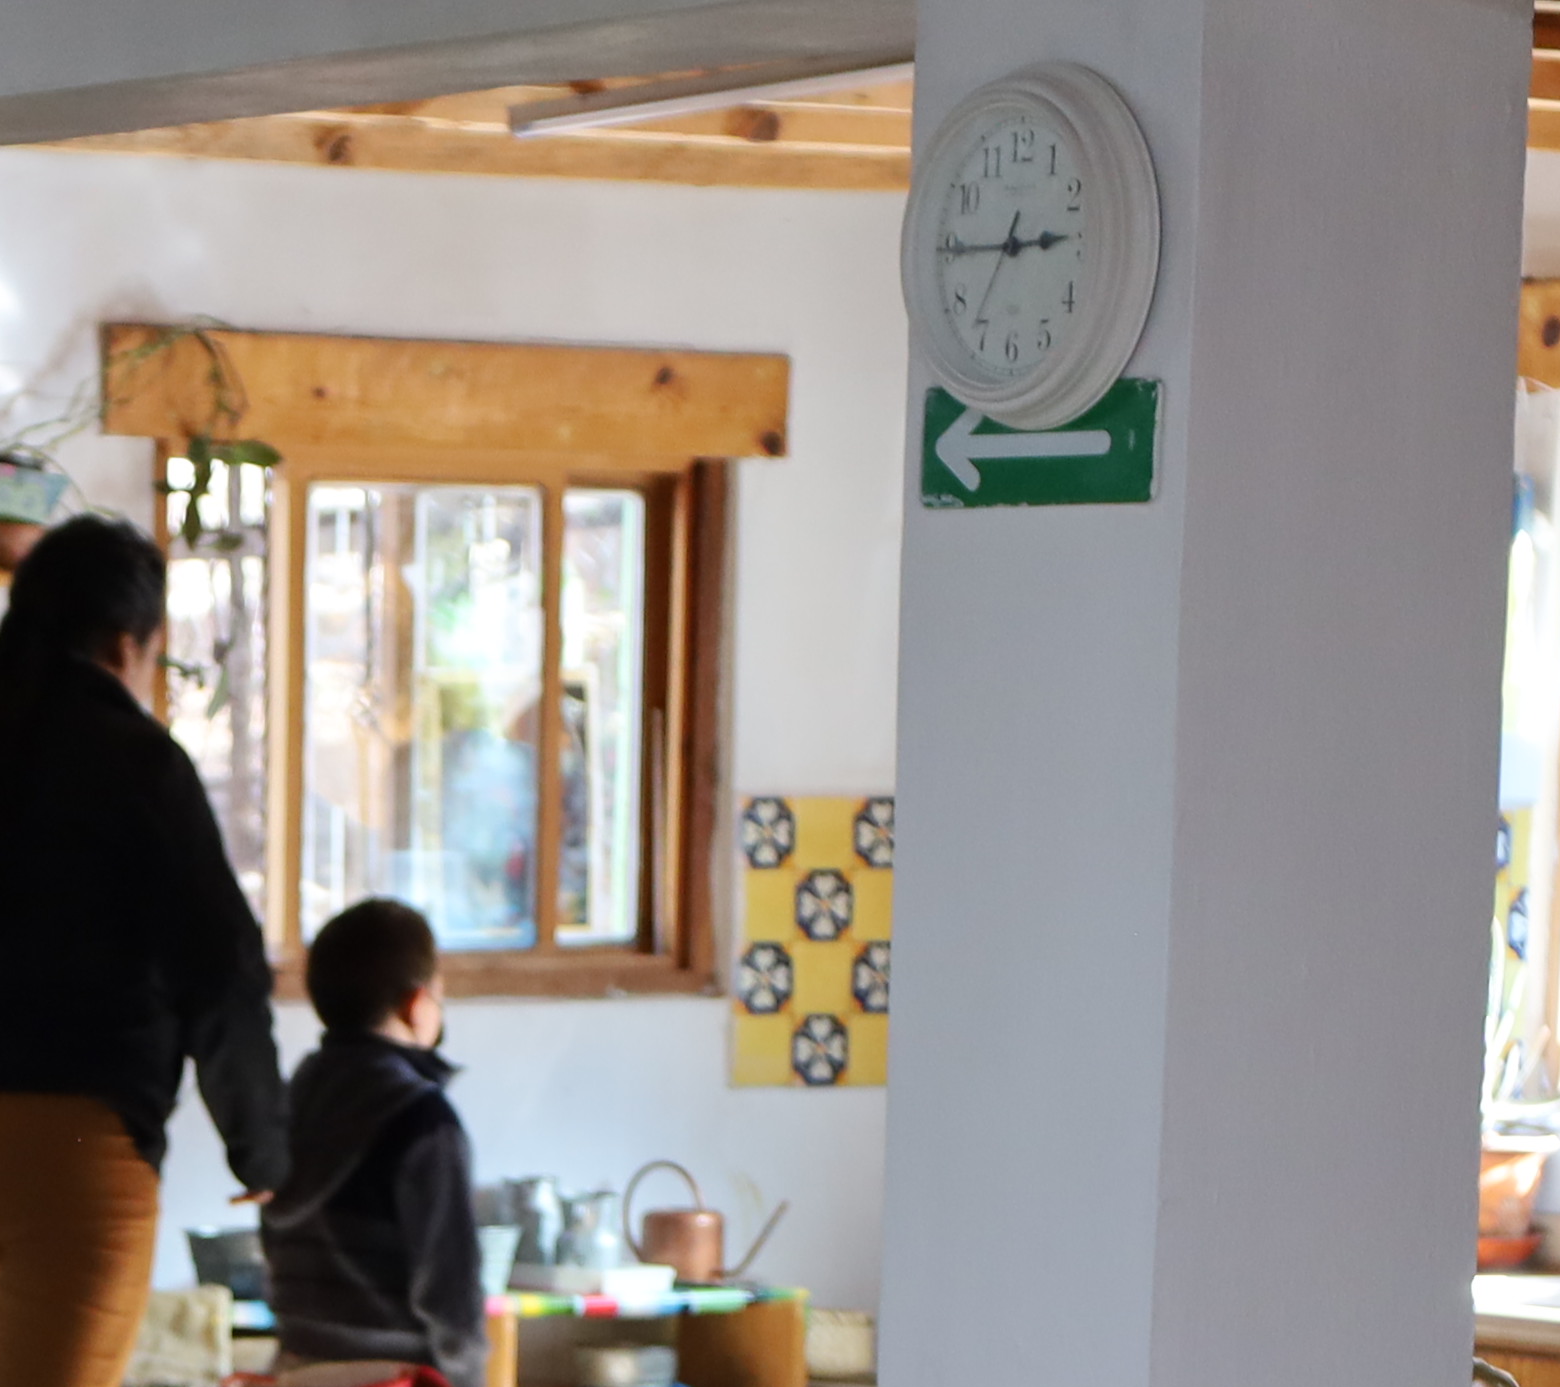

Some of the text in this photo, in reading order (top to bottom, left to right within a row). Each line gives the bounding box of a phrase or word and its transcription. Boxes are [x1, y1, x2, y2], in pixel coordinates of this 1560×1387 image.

[983, 145, 1002, 178] 11
[1011, 130, 1034, 163] 12
[1048, 143, 1057, 176] 1
[960, 181, 980, 215] 10
[1066, 178, 1081, 212] 2
[945, 231, 958, 265] 9
[953, 282, 967, 316] 8
[1061, 280, 1075, 314] 4
[976, 318, 989, 352] 7
[1005, 332, 1019, 363] 6
[1037, 318, 1051, 351] 5
